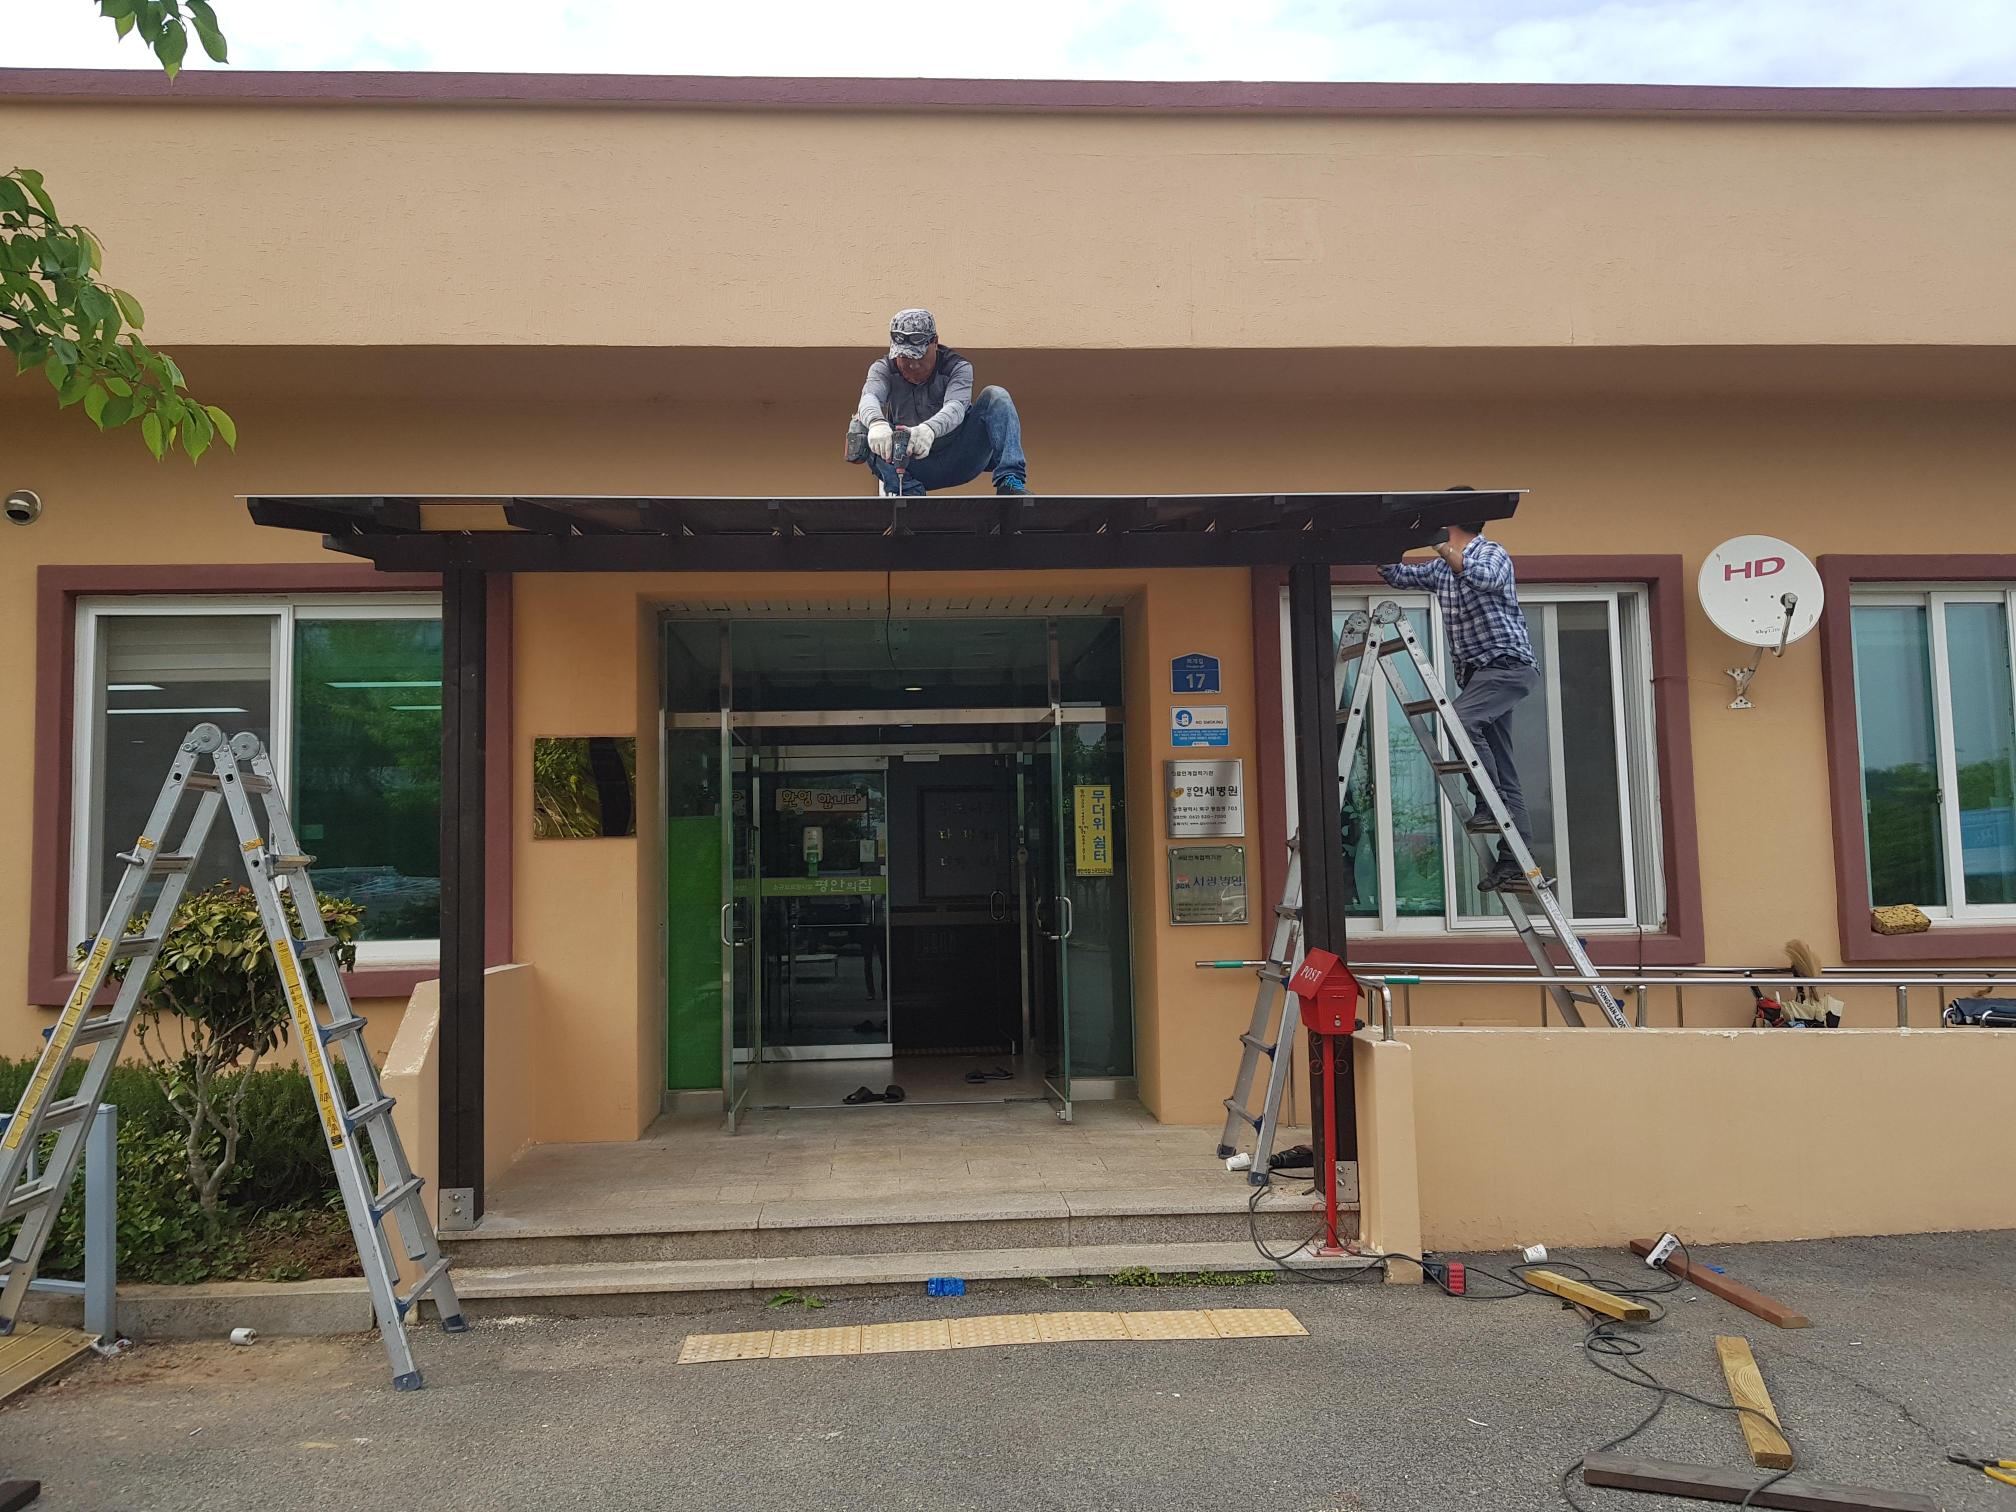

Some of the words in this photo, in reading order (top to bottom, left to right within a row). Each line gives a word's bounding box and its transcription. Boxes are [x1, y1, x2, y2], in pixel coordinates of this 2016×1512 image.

[1724, 556, 1786, 582] HD
[1186, 673, 1206, 689] 17
[782, 789, 812, 808] 환영
[1192, 785, 1239, 798] 연세병원
[1092, 789, 1106, 831] 무더위
[1092, 835, 1107, 863] 쉼터
[1300, 965, 1323, 982] POST
